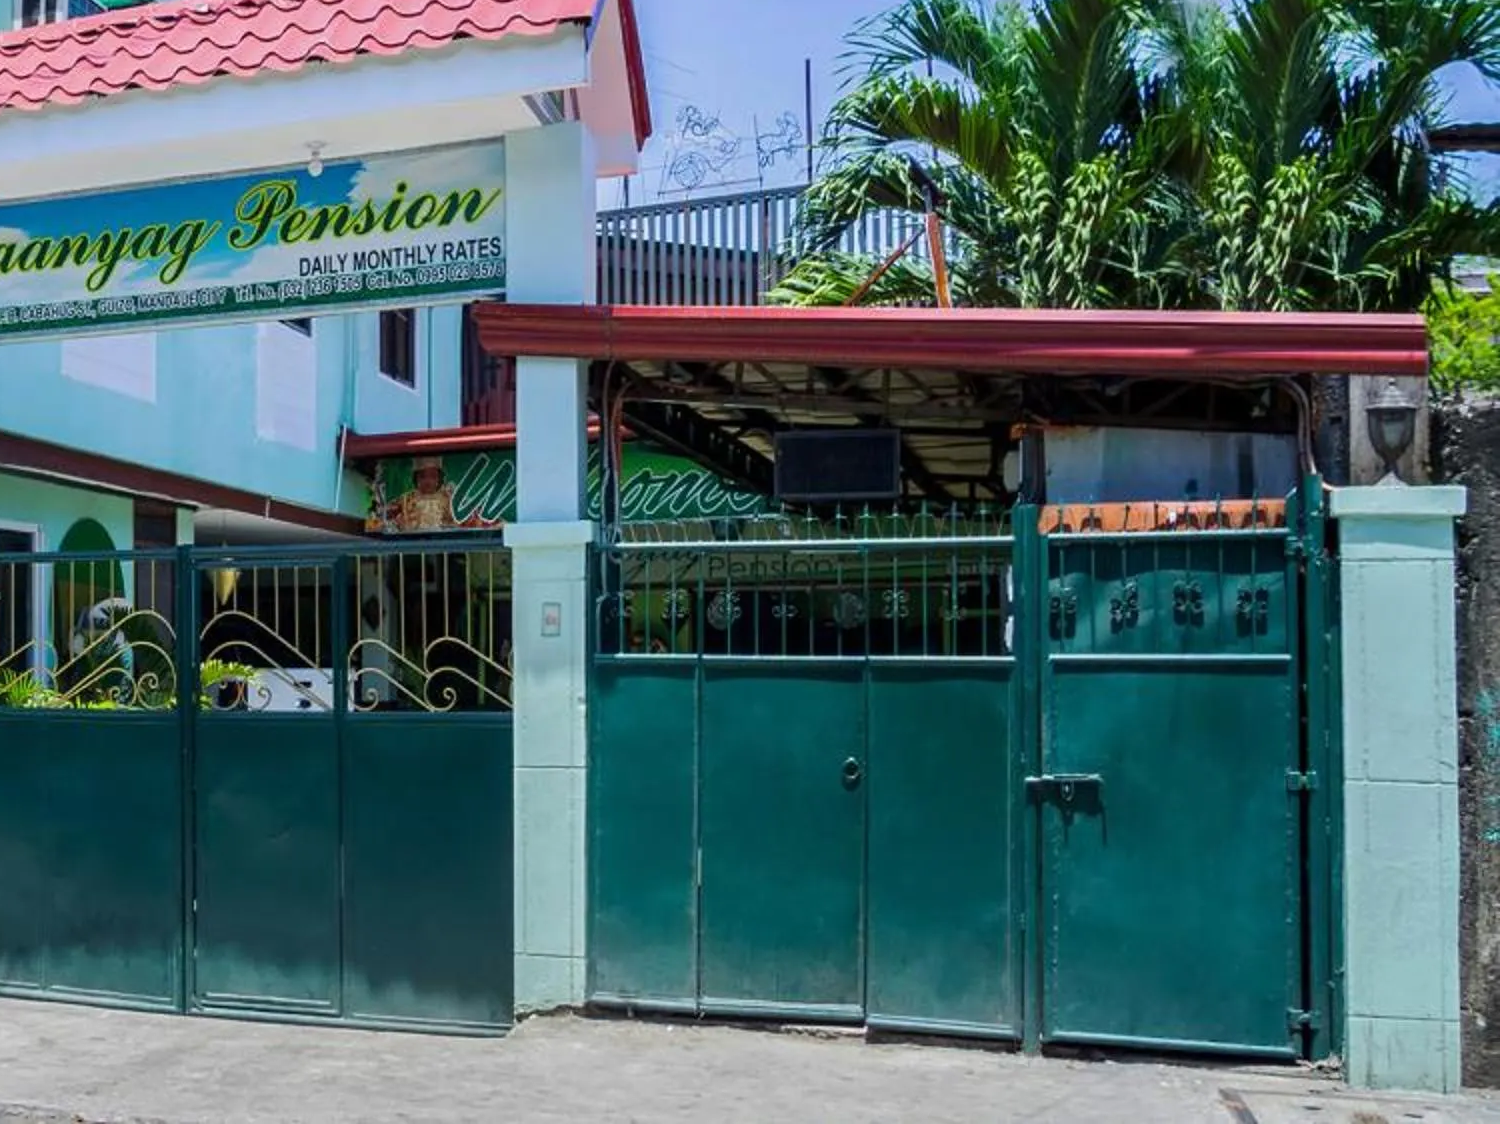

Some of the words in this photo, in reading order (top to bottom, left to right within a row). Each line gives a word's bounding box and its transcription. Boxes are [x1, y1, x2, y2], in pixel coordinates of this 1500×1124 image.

[227, 178, 503, 252] Pension
[300, 253, 348, 278] DAILY
[353, 242, 437, 271] MONTHLY
[442, 235, 502, 263] RATES
